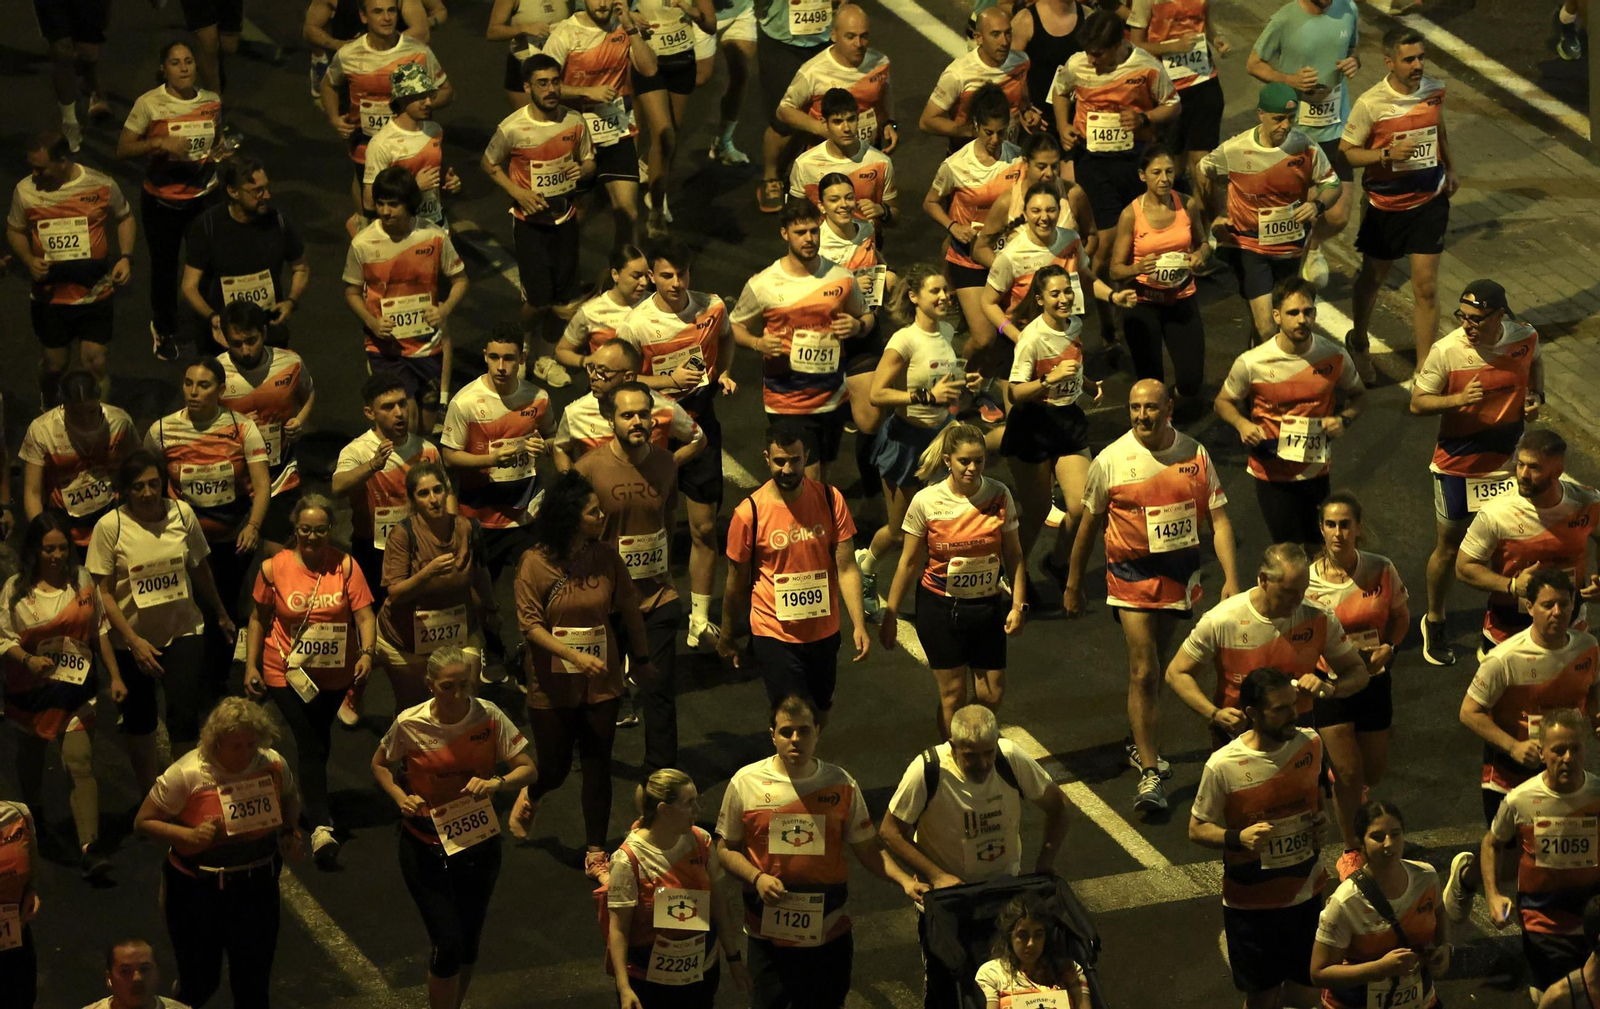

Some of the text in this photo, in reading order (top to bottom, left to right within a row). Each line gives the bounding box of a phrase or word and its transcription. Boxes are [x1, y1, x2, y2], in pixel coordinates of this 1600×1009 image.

[794, 10, 827, 25] 24498
[660, 30, 688, 46] 1948
[1168, 51, 1203, 69] 22142
[1309, 103, 1335, 115] 8674
[593, 116, 619, 132] 8764
[1092, 128, 1128, 141] 14873
[859, 170, 877, 181] KH7
[48, 234, 79, 250] 6522
[823, 287, 843, 298] KH7
[696, 317, 715, 330] KH7
[798, 348, 834, 362] 10751
[274, 375, 292, 388] KH7
[521, 408, 537, 418] KH7
[1285, 434, 1321, 450] 17733
[1179, 465, 1198, 476] KH7
[68, 480, 108, 506] 21433
[188, 480, 228, 494] 19672
[1154, 520, 1192, 539] 14373
[1568, 516, 1589, 529] KH7
[788, 526, 825, 544] GIRO
[950, 539, 986, 548] NOCTURNA
[625, 551, 663, 566] 23242
[137, 574, 179, 595] 20094
[952, 572, 992, 587] 22013
[311, 591, 343, 609] GIRO
[781, 589, 822, 607] 19699
[420, 625, 460, 643] 23237
[1291, 629, 1313, 643] KH7
[296, 640, 338, 655] 20985
[1295, 754, 1312, 769] KH7
[817, 794, 840, 806] KH7
[229, 798, 272, 820] 23578
[444, 812, 490, 840] 23586
[1542, 838, 1590, 854] 21059
[774, 910, 810, 928] 1120
[655, 956, 698, 973] 22284
[1375, 987, 1418, 1008] 1220
